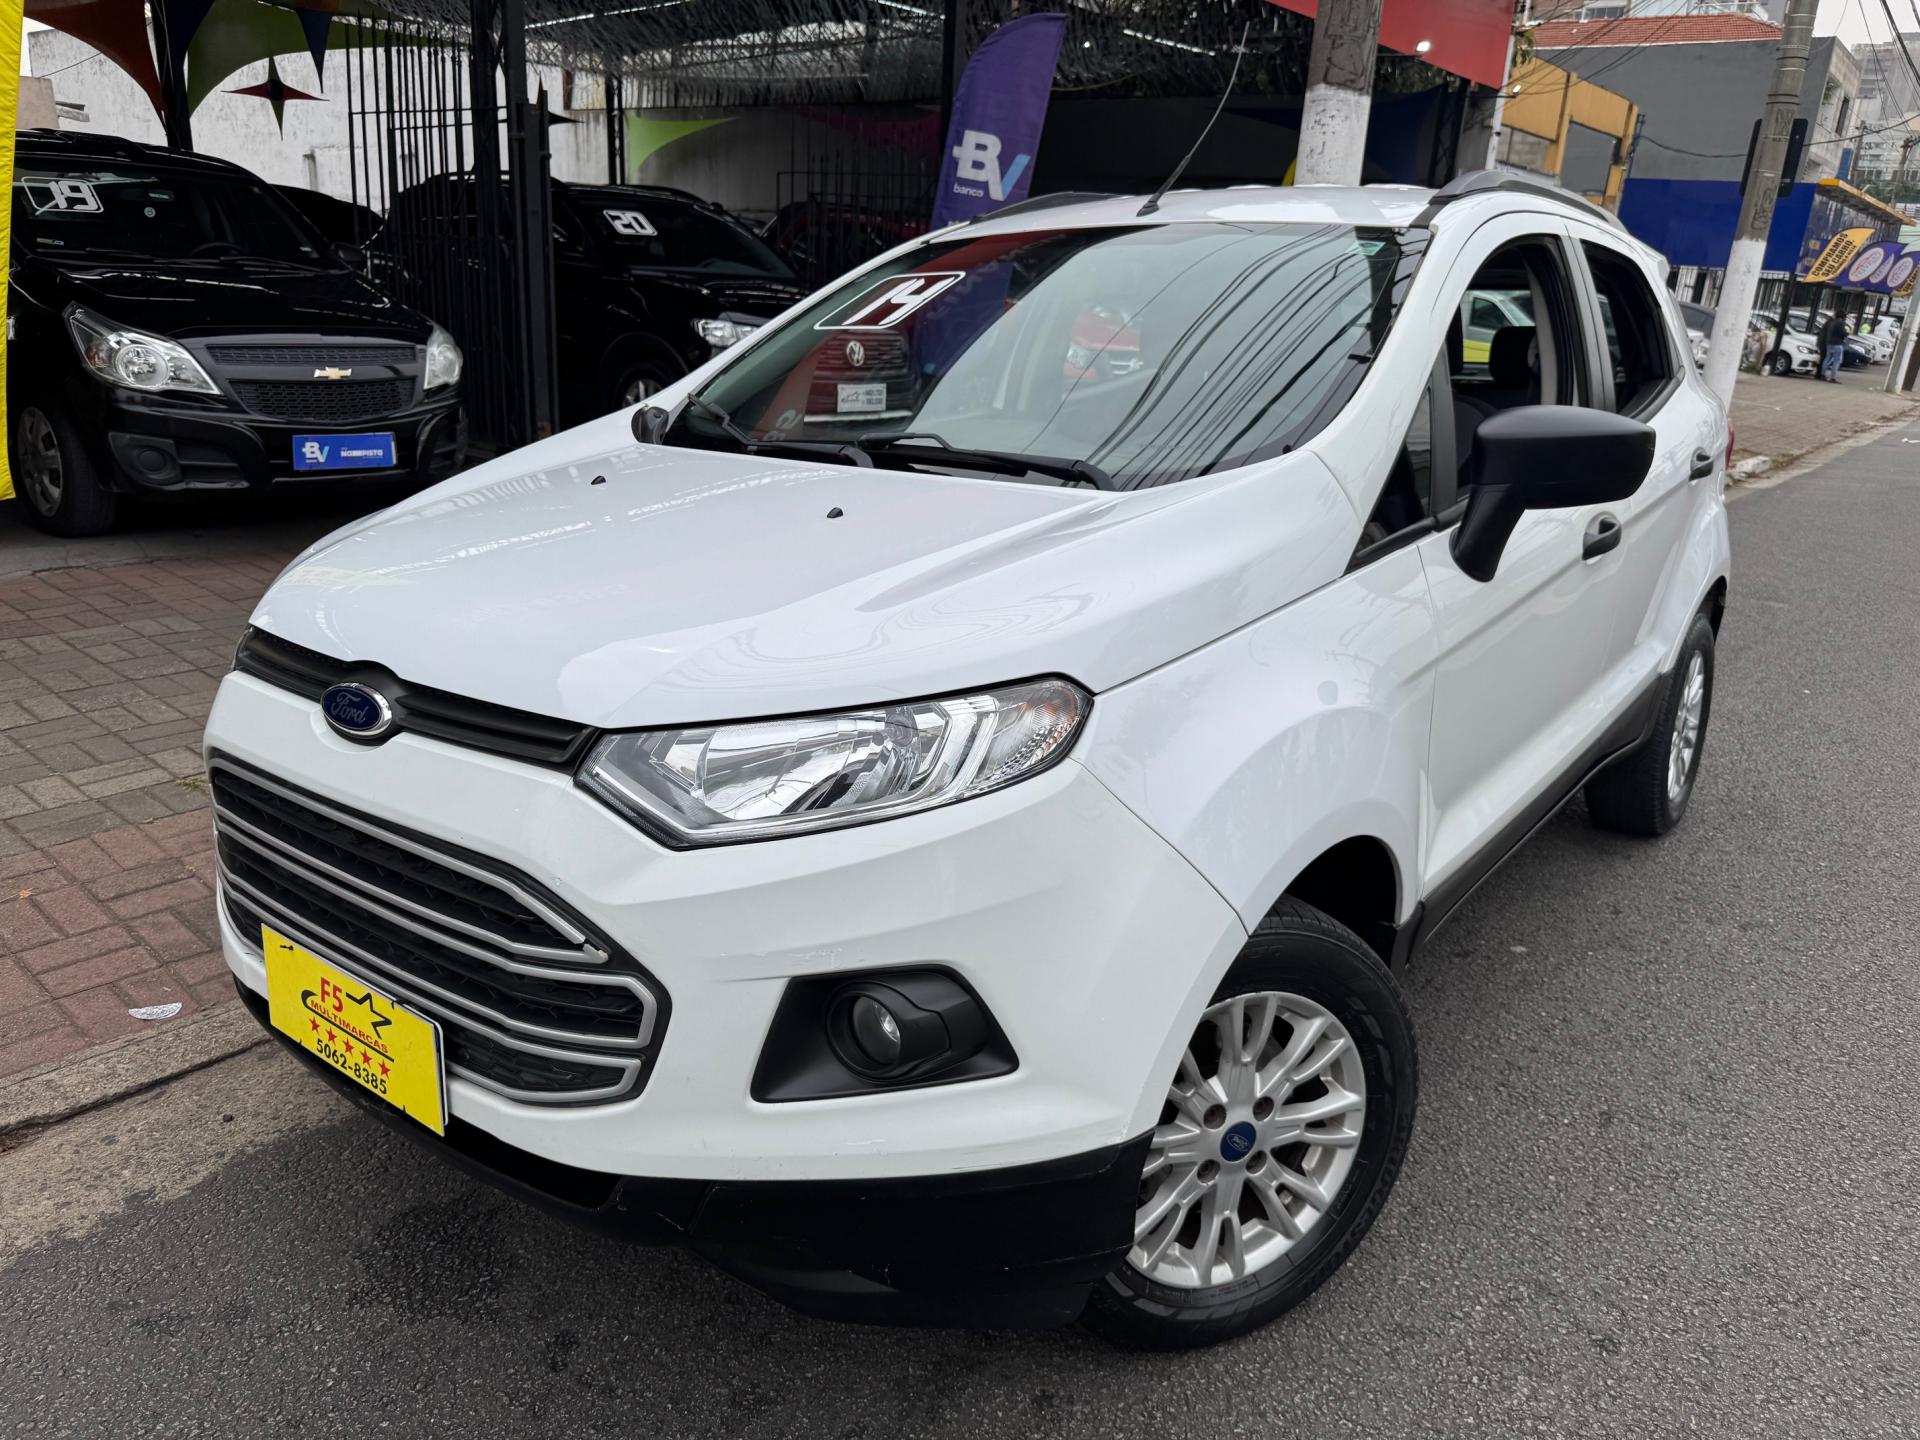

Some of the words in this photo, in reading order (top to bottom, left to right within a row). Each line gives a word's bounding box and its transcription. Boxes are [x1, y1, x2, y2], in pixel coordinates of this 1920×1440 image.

[952, 129, 1031, 201] BV
[49, 180, 99, 211] 19
[953, 182, 984, 198] banco
[607, 212, 656, 234] 20
[1811, 232, 1849, 277] COMPRAMOS
[1821, 261, 1837, 278] SEU
[841, 276, 955, 326] 14
[302, 441, 330, 463] BV
[331, 691, 369, 723] Ford
[320, 976, 344, 1013] F5
[310, 999, 389, 1054] MULTIMARCAS
[316, 1037, 388, 1096] 5062-8385
